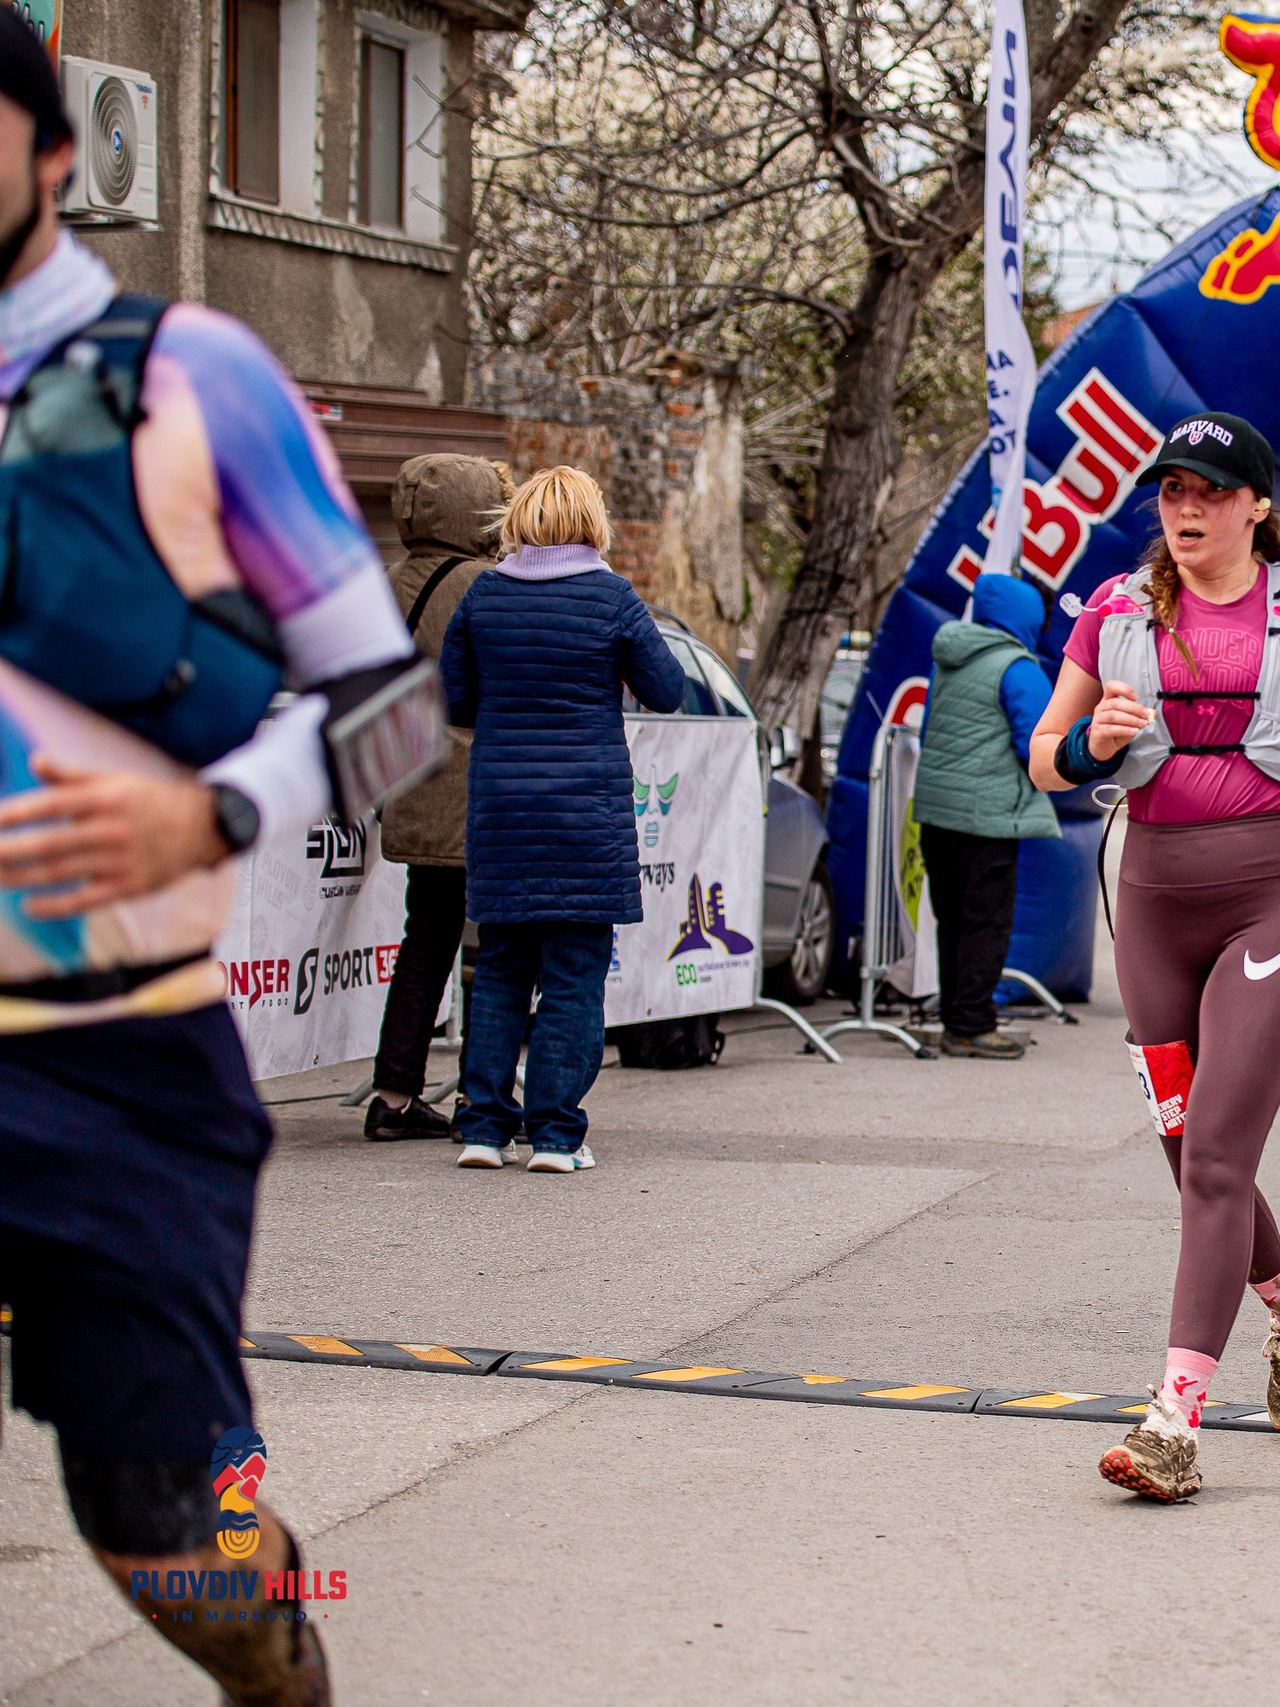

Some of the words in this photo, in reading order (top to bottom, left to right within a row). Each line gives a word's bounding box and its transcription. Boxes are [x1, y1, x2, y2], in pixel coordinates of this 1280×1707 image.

[1169, 420, 1234, 447] HARVARD
[982, 375, 1161, 583] Bull
[323, 946, 374, 996] SPORT
[675, 964, 698, 987] ECO
